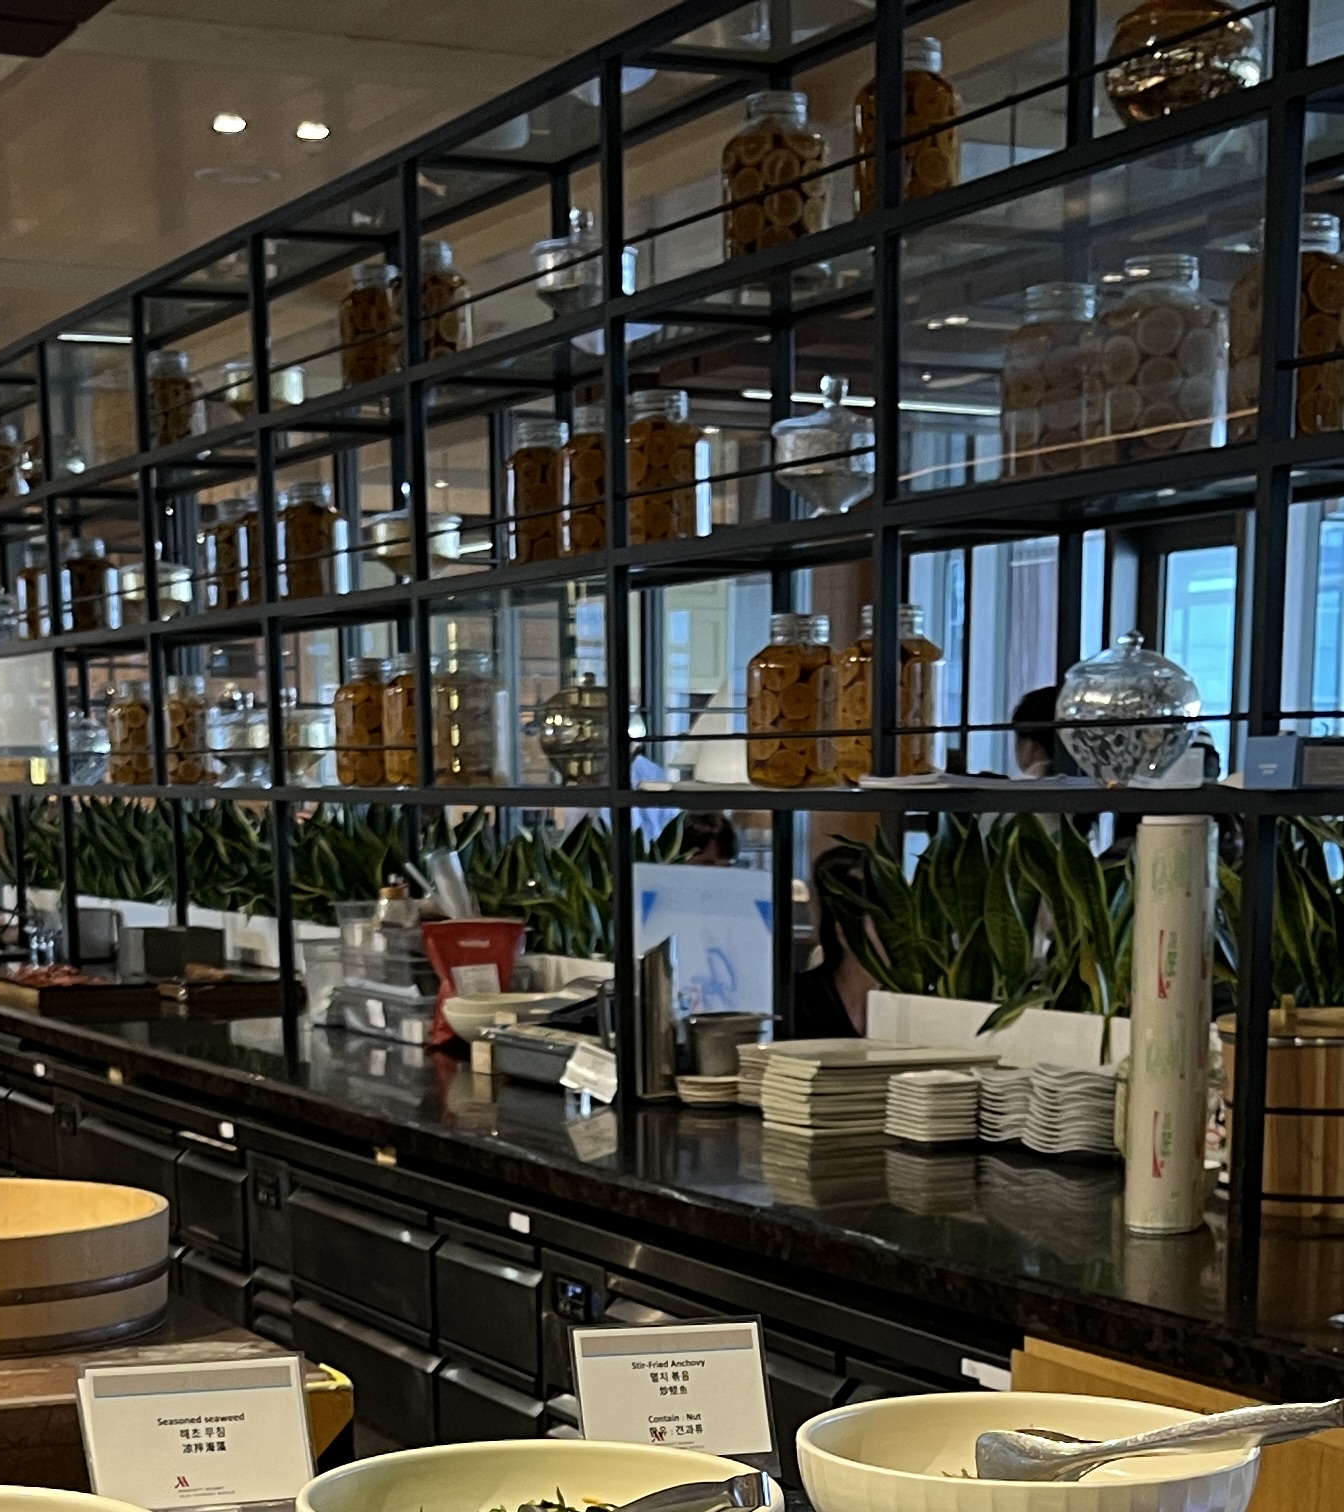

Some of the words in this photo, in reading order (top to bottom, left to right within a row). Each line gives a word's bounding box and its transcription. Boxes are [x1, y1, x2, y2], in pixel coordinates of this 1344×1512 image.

[631, 1360, 669, 1370] Stir-Fried
[670, 1359, 705, 1368] Anchovy
[157, 1415, 202, 1426] Seasoned
[204, 1412, 245, 1423] seaweed
[648, 1414, 680, 1424] Contain
[686, 1413, 702, 1421] Nut
